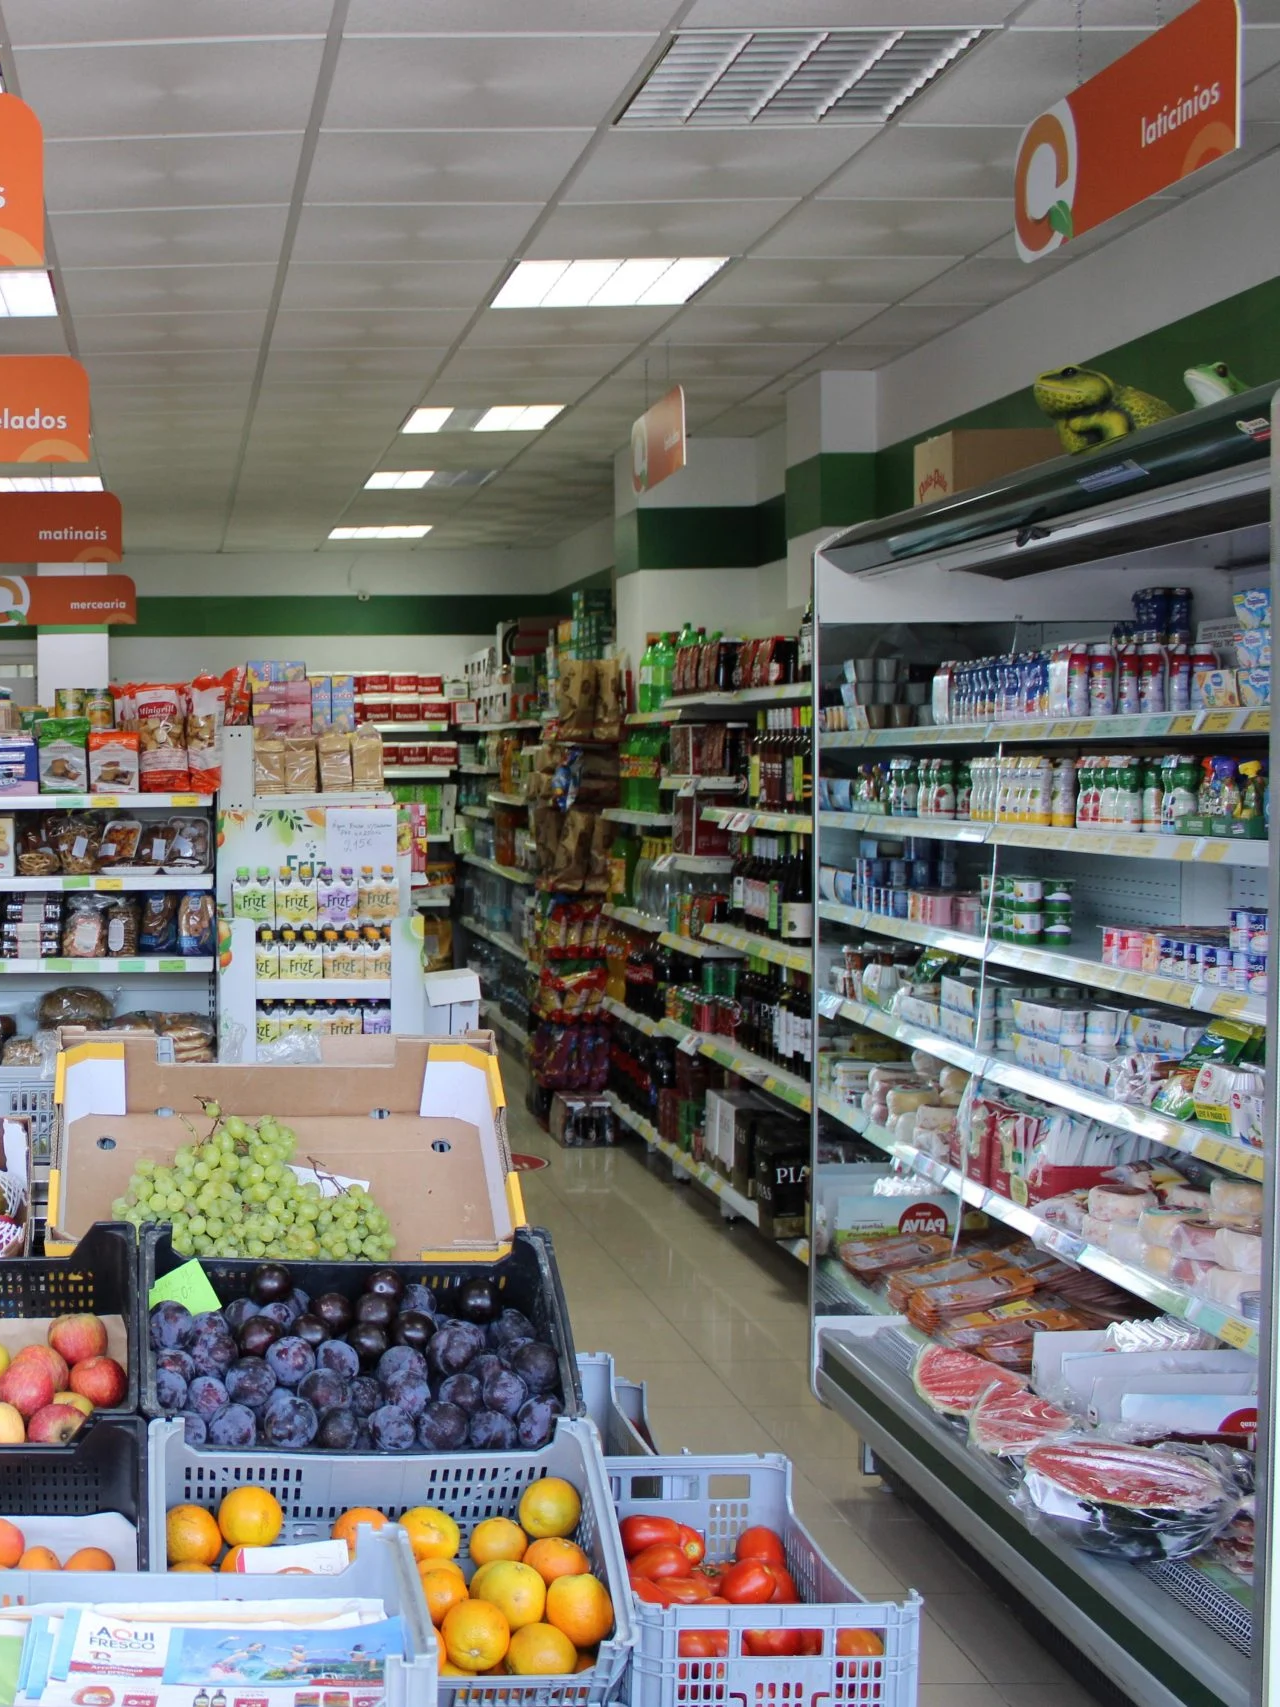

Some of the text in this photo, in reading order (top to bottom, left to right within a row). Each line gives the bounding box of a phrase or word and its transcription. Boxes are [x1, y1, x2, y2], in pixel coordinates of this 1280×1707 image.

[1140, 81, 1220, 149] laticínios
[38, 526, 108, 541] matinais
[69, 598, 126, 610] mercearia
[286, 850, 327, 878] Friz
[256, 959, 270, 974] izE
[374, 958, 391, 974] Friz
[256, 1023, 270, 1038] izE
[373, 1021, 391, 1034] Friz
[96, 1626, 155, 1642] AQUI
[89, 1636, 156, 1650] FRESCO
